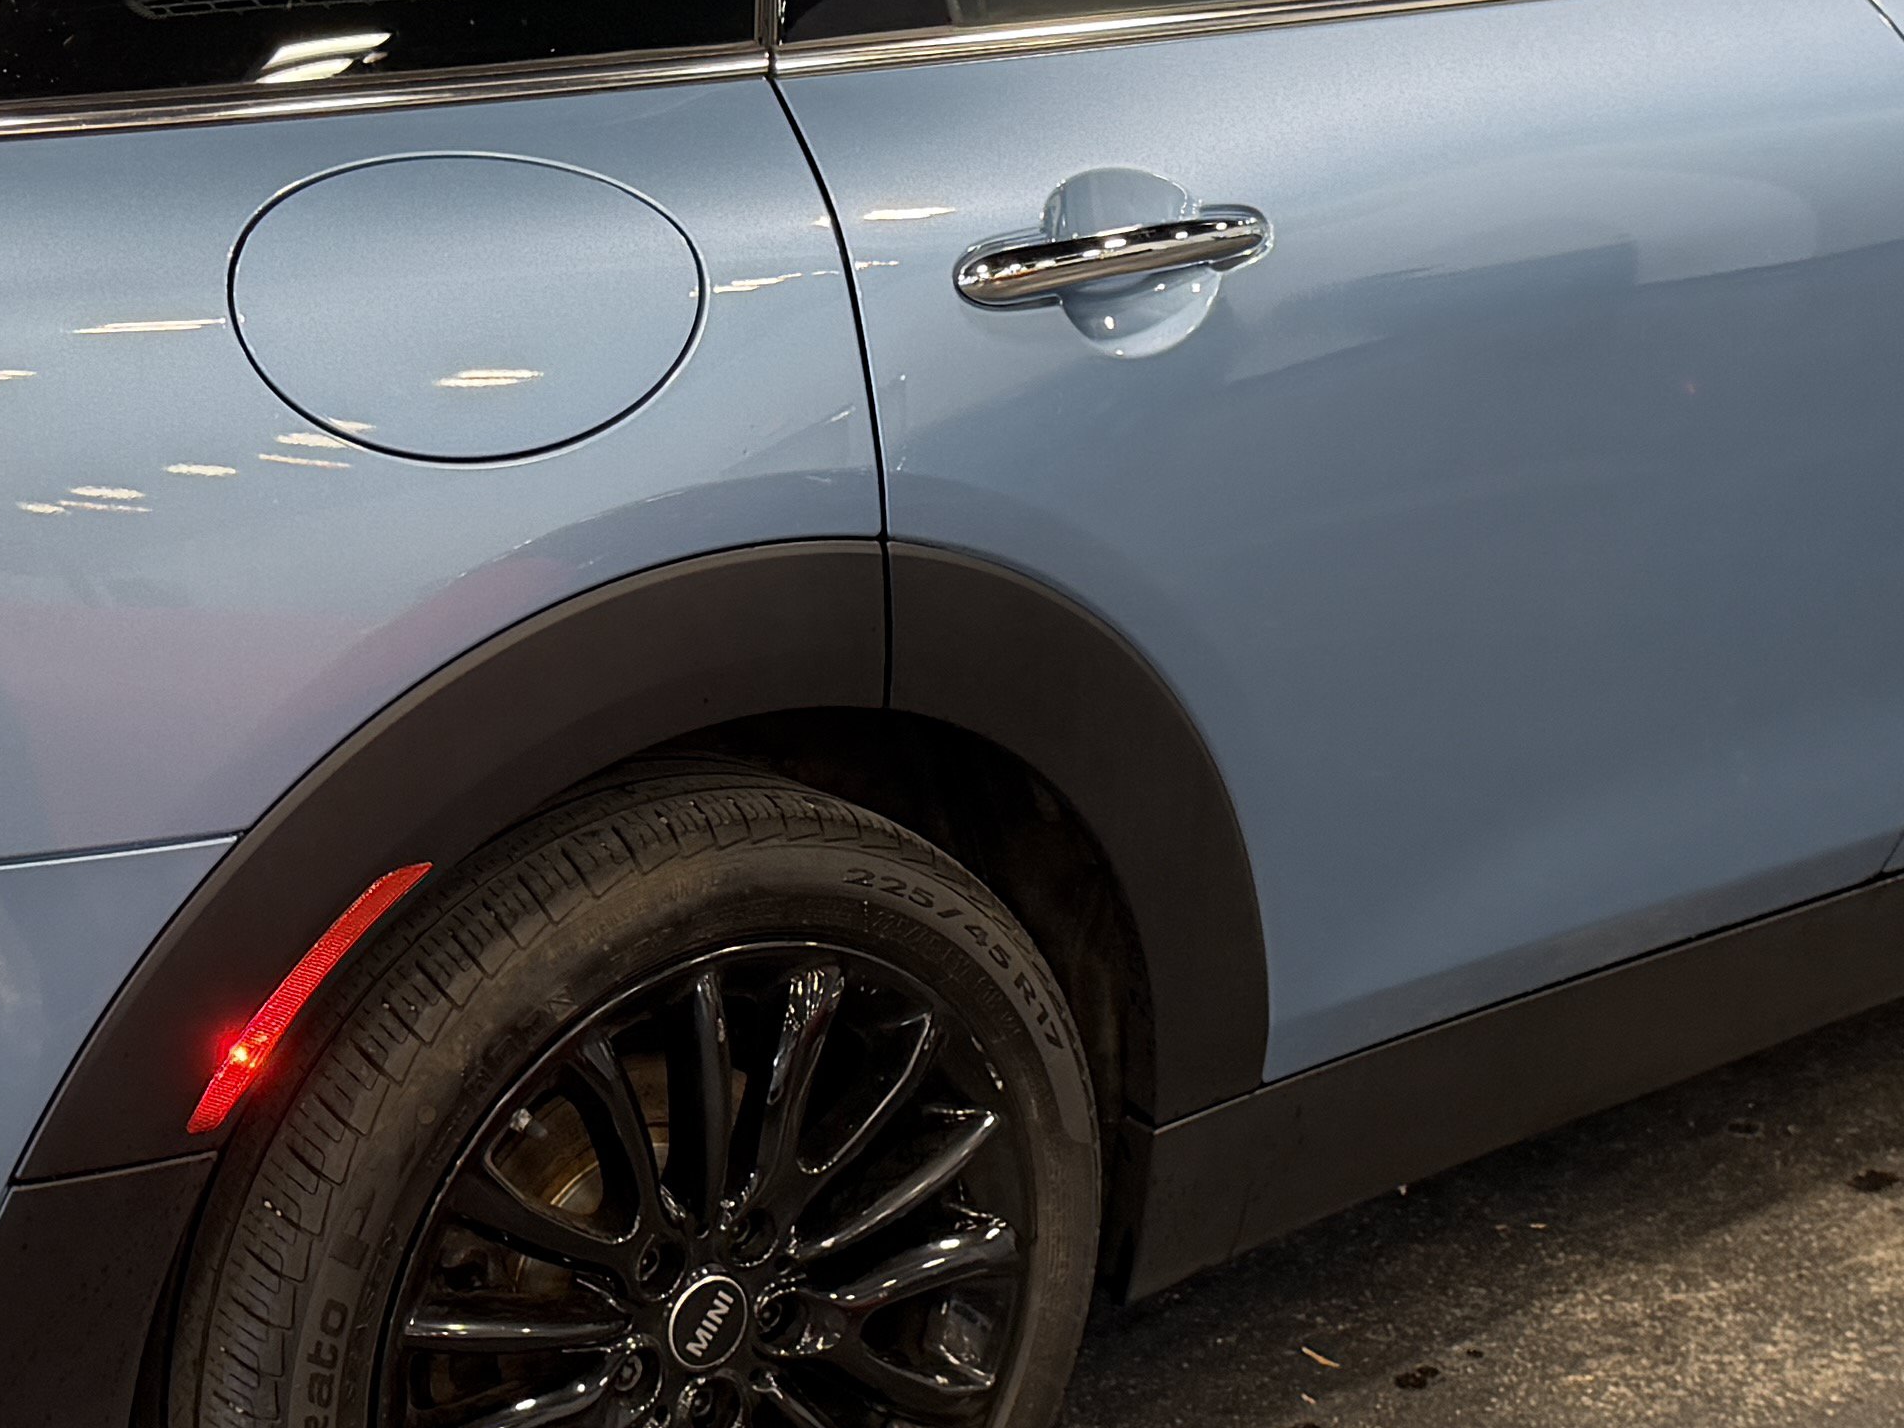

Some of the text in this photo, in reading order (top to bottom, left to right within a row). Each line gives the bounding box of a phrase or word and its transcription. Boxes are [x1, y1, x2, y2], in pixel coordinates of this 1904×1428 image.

[843, 867, 1012, 970] 225/45
[1013, 971, 1065, 1050] R17
[685, 1290, 734, 1358] MINI
